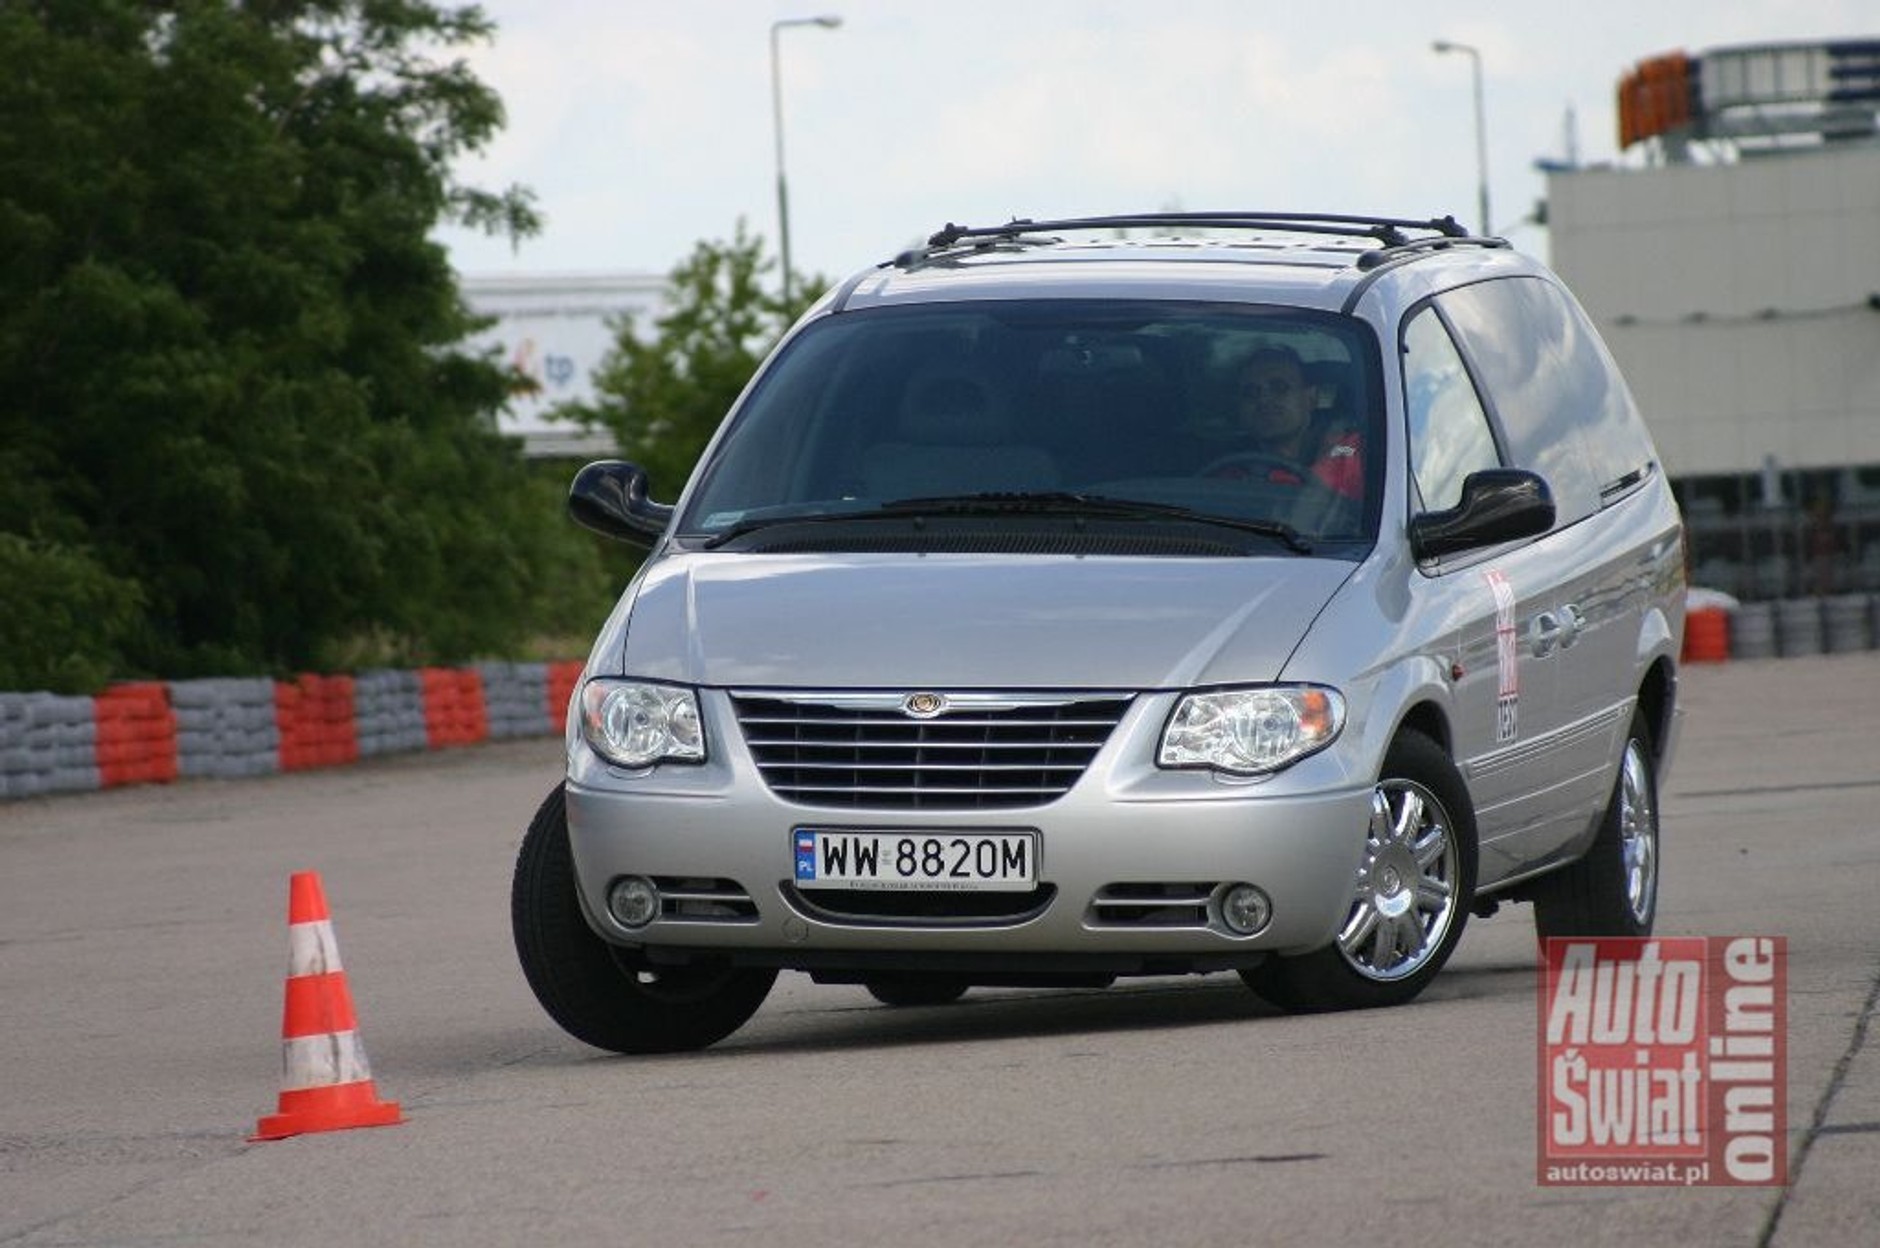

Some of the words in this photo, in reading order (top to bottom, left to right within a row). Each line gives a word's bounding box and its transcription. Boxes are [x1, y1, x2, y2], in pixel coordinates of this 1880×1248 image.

[799, 860, 814, 872] PL
[822, 837, 879, 876] WW
[896, 838, 1026, 878] 8820M
